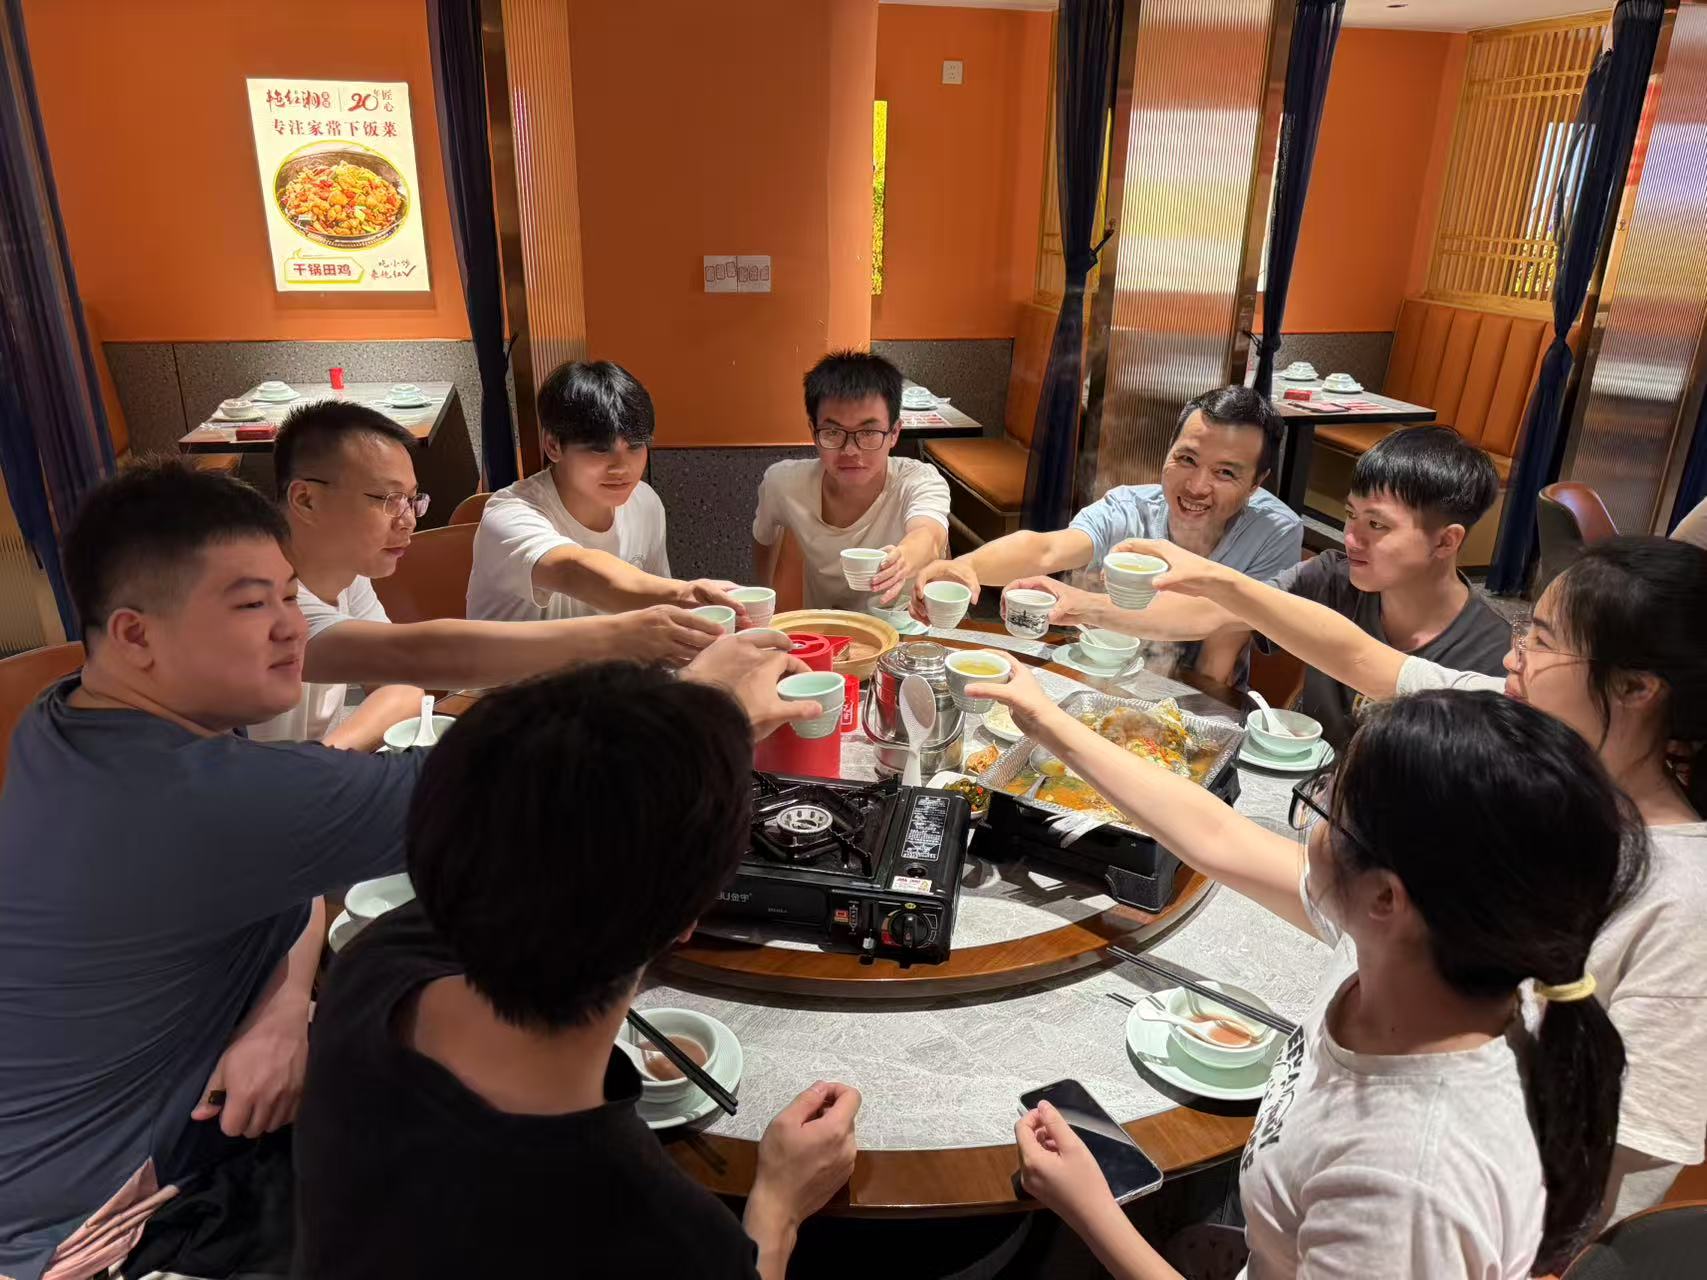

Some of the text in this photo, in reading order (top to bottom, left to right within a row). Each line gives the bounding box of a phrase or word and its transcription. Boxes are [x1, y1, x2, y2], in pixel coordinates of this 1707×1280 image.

[274, 118, 397, 137] 专注家常下饭菜
[293, 263, 352, 276] 干锅田鸡
